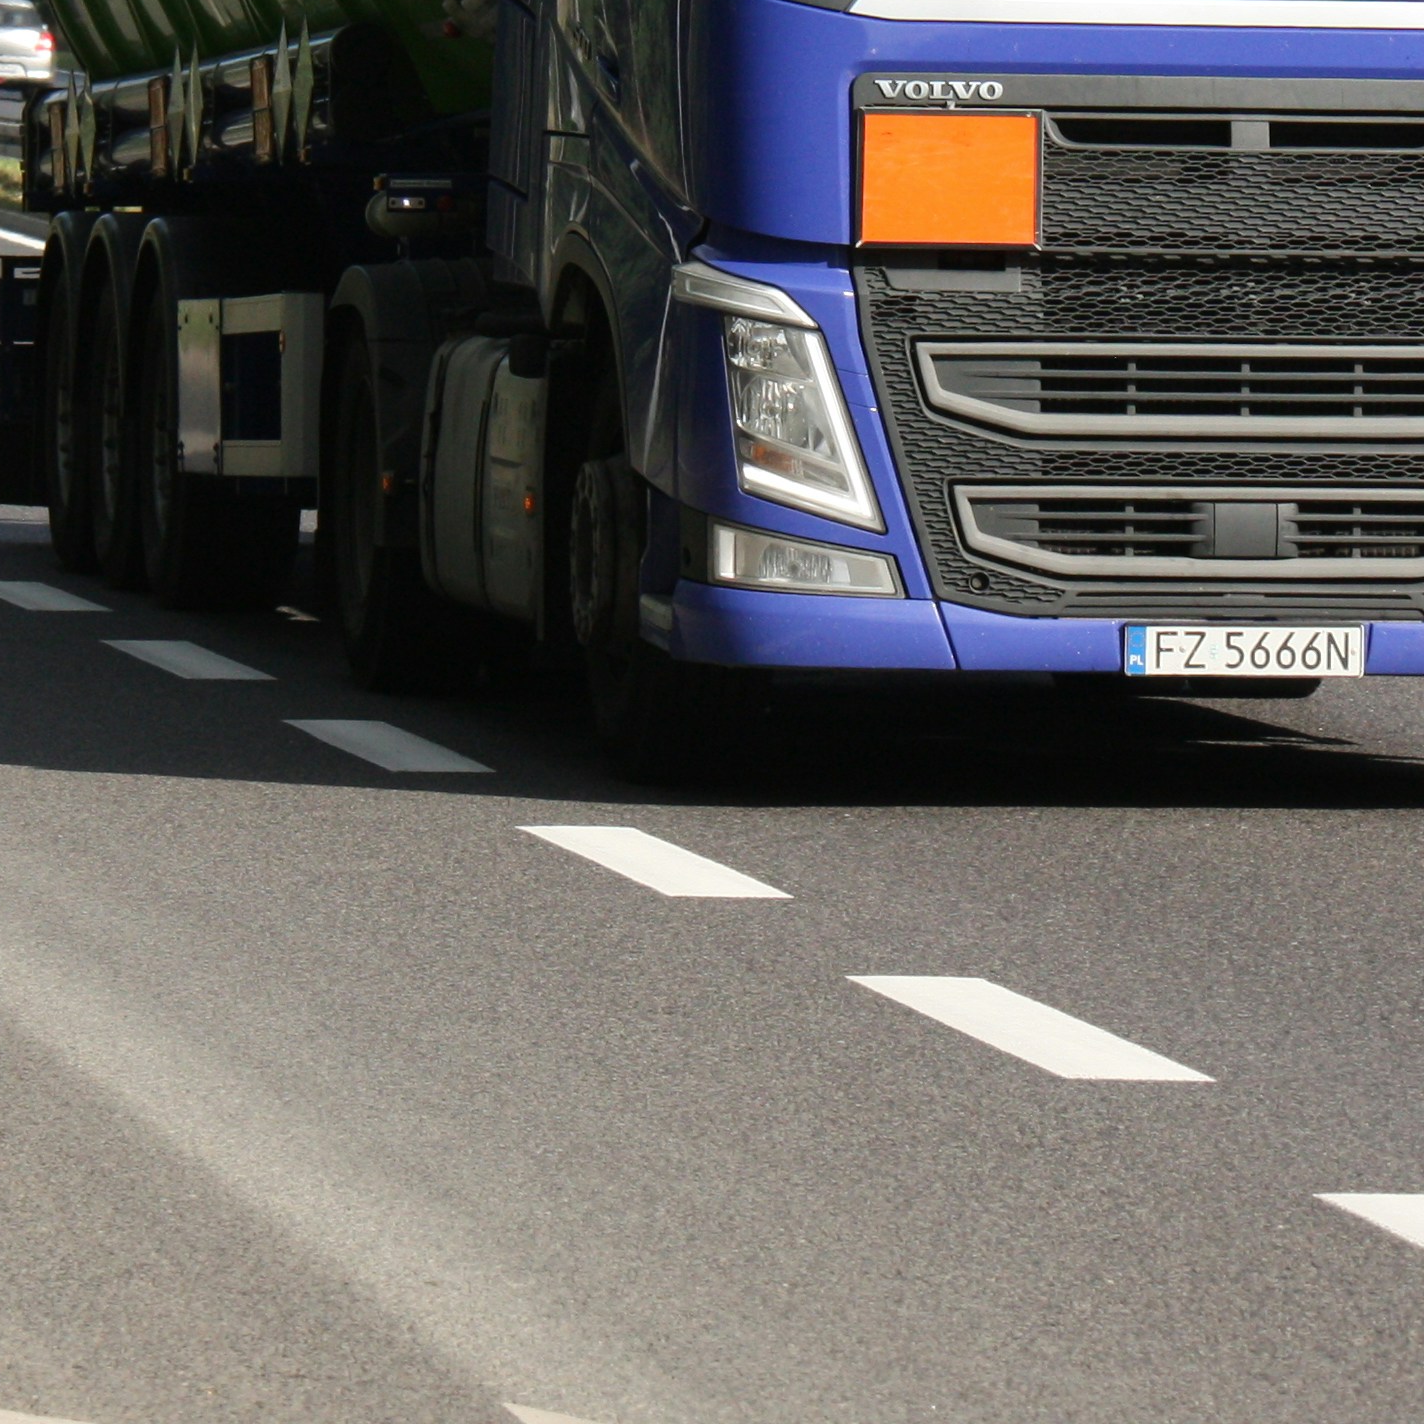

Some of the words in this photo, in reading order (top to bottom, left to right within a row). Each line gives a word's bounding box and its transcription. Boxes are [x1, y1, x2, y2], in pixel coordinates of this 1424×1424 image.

[874, 79, 1004, 101] VOLVO
[1129, 655, 1144, 666] PL
[1155, 631, 1207, 669] FZ
[1225, 631, 1349, 670] 5666N
